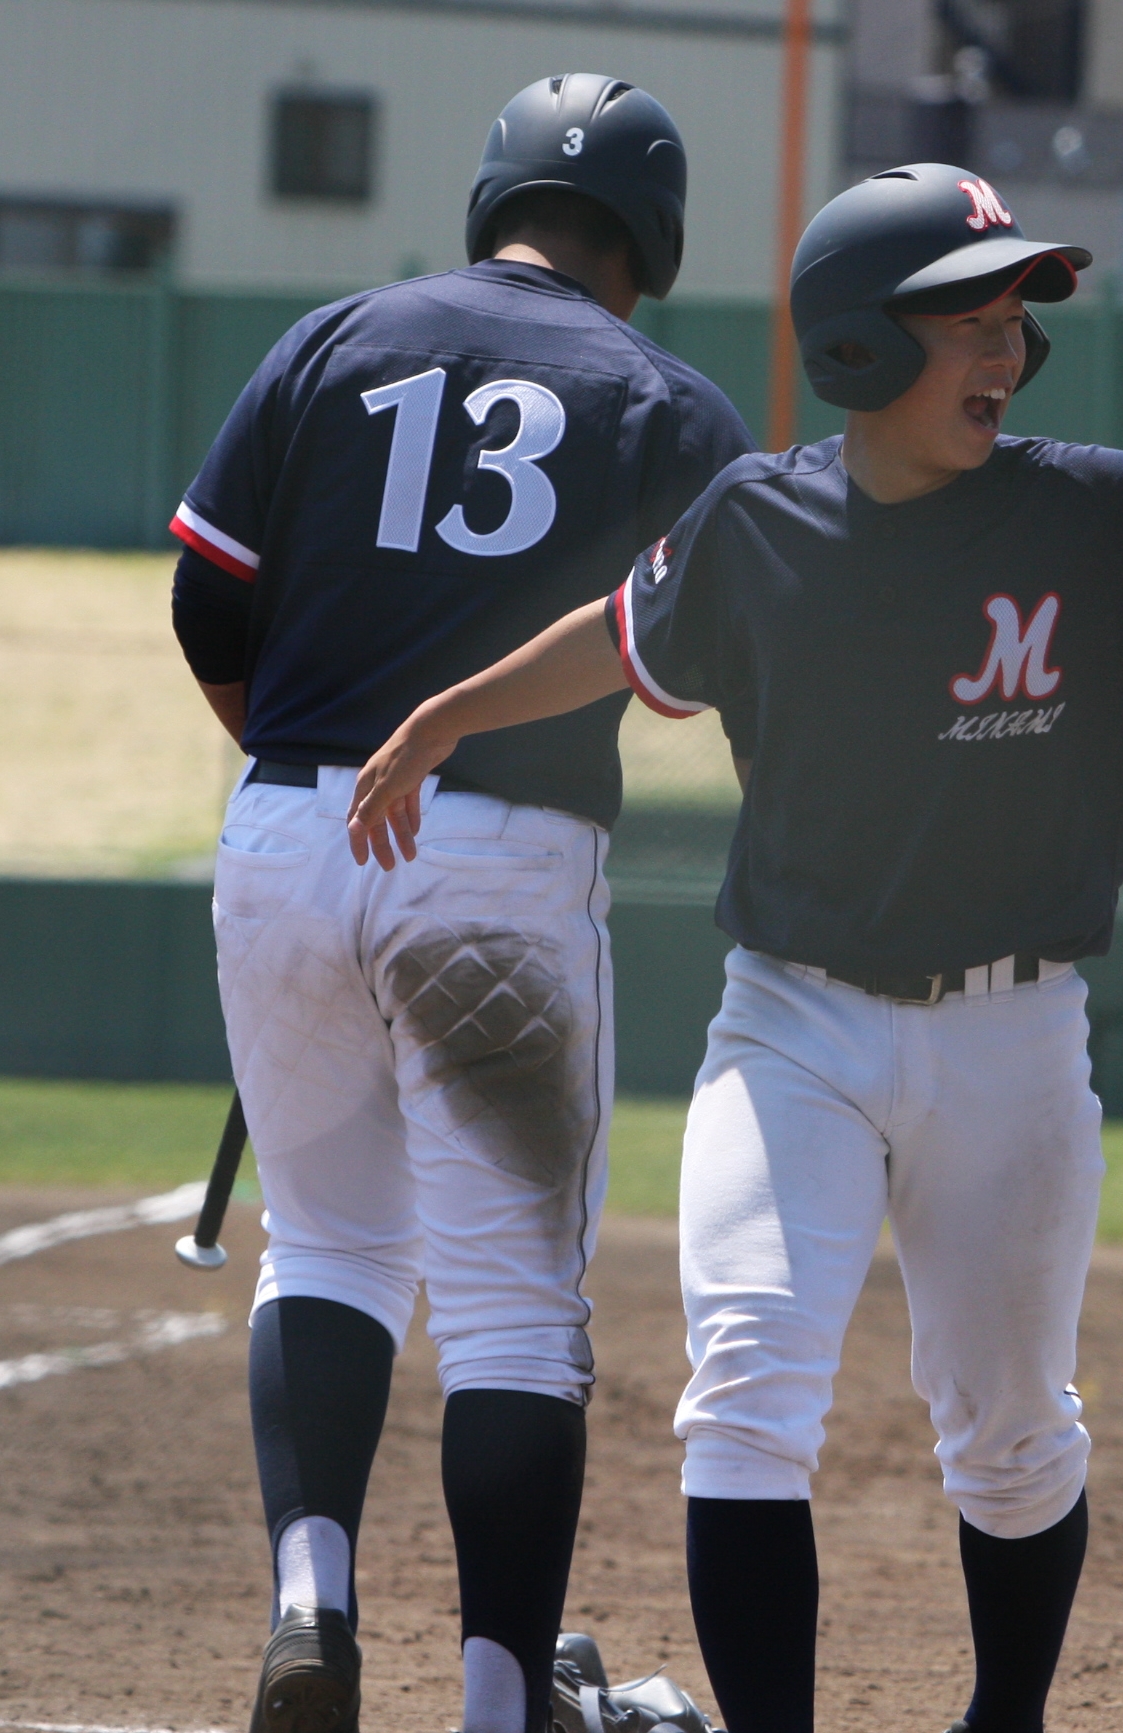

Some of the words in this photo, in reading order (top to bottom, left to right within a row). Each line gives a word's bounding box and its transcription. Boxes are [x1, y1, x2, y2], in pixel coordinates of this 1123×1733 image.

[562, 127, 584, 156] 3
[957, 179, 1013, 232] M
[361, 368, 566, 556] 13
[951, 593, 1062, 704] M
